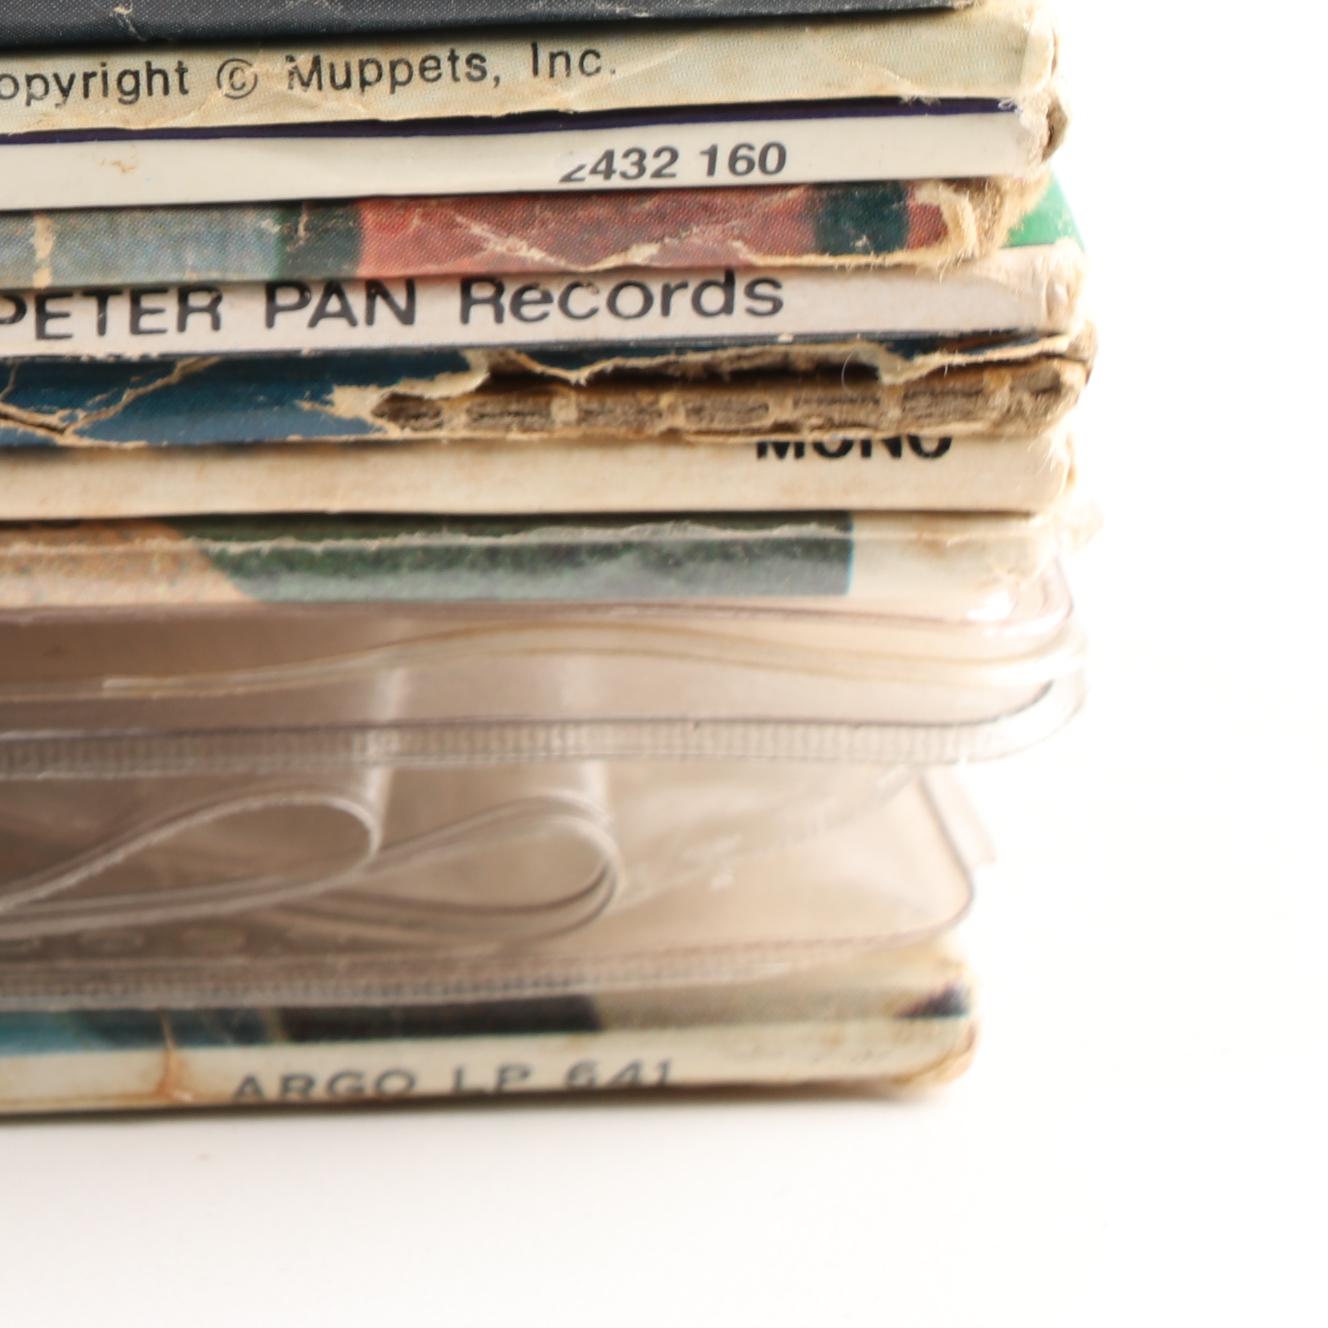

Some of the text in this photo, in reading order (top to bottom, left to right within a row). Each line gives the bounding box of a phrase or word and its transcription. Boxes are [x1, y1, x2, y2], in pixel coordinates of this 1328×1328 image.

[286, 46, 501, 95] Muppets,
[529, 41, 617, 79] Inc.
[699, 141, 788, 177] 160
[264, 281, 418, 328] PAN
[458, 270, 785, 325] Records
[231, 1058, 676, 1104] ARGO LP 641
